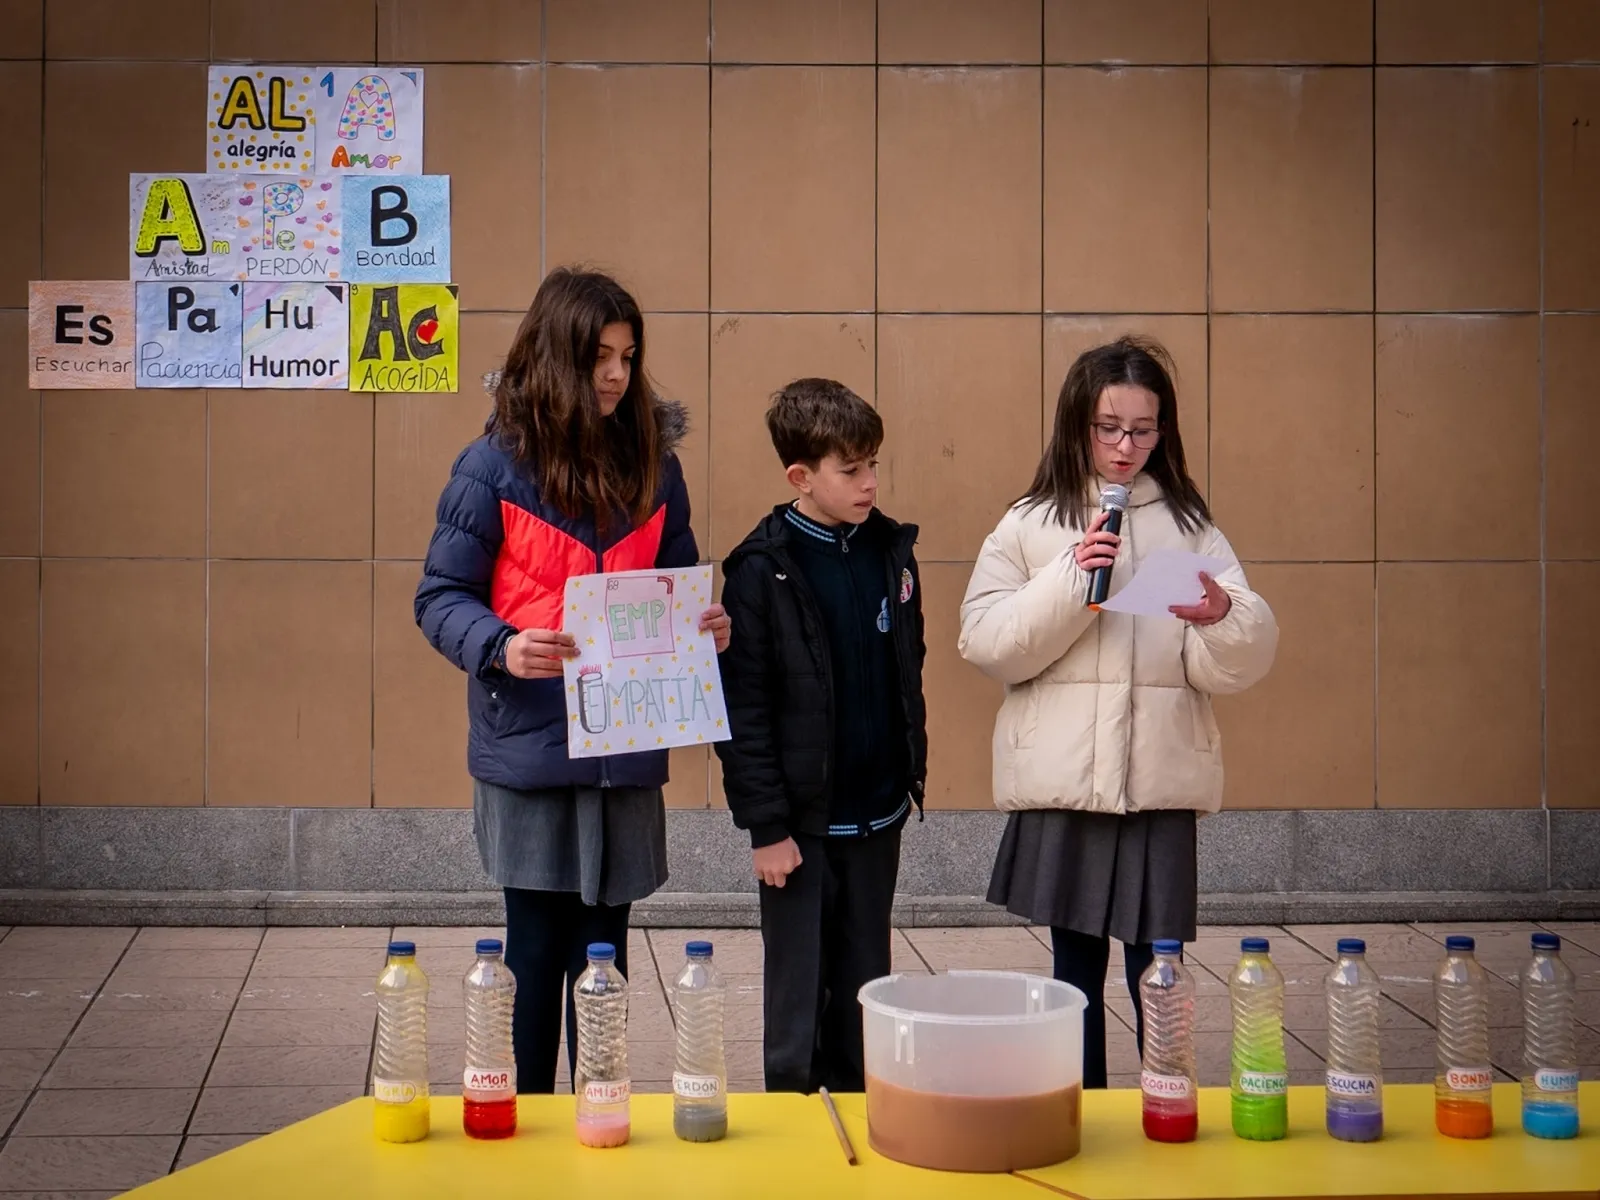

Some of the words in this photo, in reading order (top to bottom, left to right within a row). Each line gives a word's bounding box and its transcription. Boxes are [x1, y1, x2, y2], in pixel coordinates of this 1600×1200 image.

[320, 71, 334, 97] 1
[218, 76, 306, 132] AL
[338, 75, 396, 141] A
[227, 138, 296, 161] alegría
[331, 145, 402, 169] Amor
[371, 185, 417, 246] B
[145, 257, 216, 277] Amistad
[247, 254, 328, 276] PERDÓN
[356, 246, 436, 266] Bondad
[168, 286, 221, 333] Pa
[265, 299, 314, 330] Hu
[55, 305, 114, 346] Es
[35, 356, 132, 373] Escuchar
[141, 341, 242, 379] Paciencia
[250, 355, 340, 378] Humor
[608, 599, 665, 641] EMP
[586, 667, 711, 728] EMPATÍA
[470, 1073, 508, 1086] AMOR
[1327, 1075, 1375, 1090] ESCUCHA
